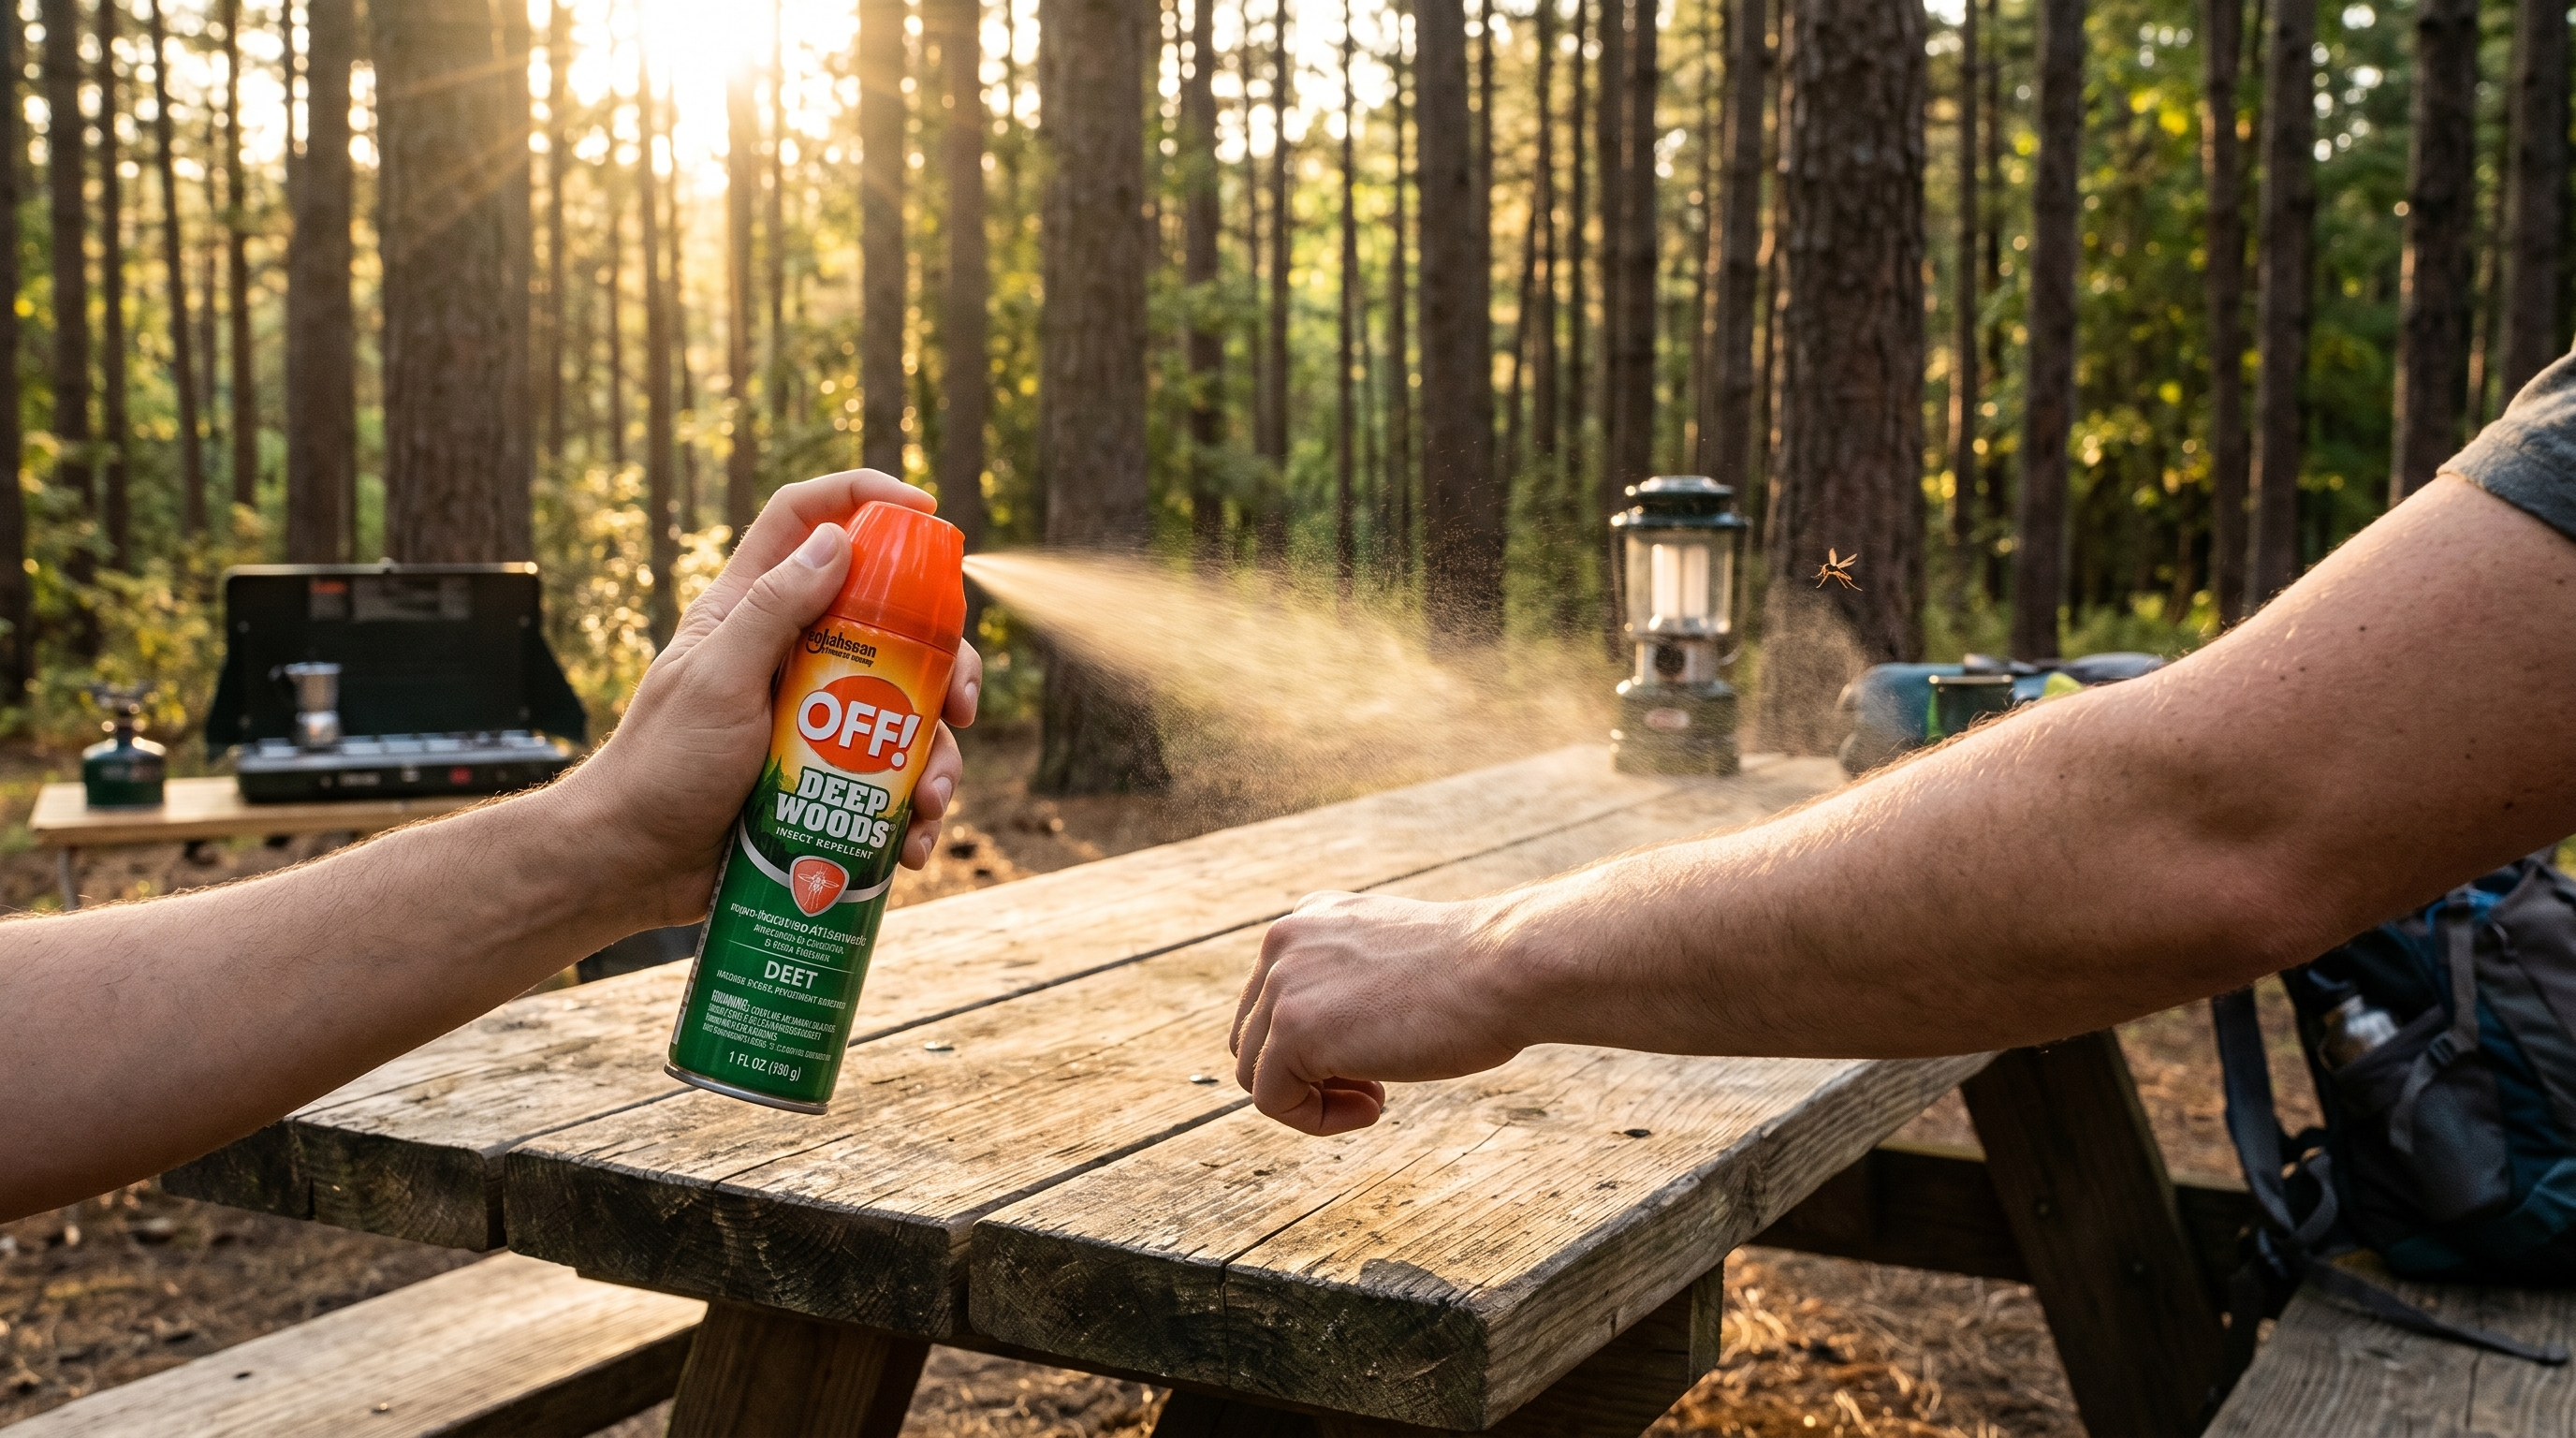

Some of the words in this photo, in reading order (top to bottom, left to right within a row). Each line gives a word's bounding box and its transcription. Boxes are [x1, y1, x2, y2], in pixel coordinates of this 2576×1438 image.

[798, 691, 921, 768] OFF!
[798, 769, 888, 817] DEEP
[776, 827, 813, 844] INSECT
[815, 839, 874, 859] REPELLENT
[764, 960, 819, 990] DEET
[729, 1051, 735, 1064] 1
[737, 1053, 749, 1068] FL
[752, 1058, 768, 1072] OZ
[789, 1066, 801, 1081] g)
